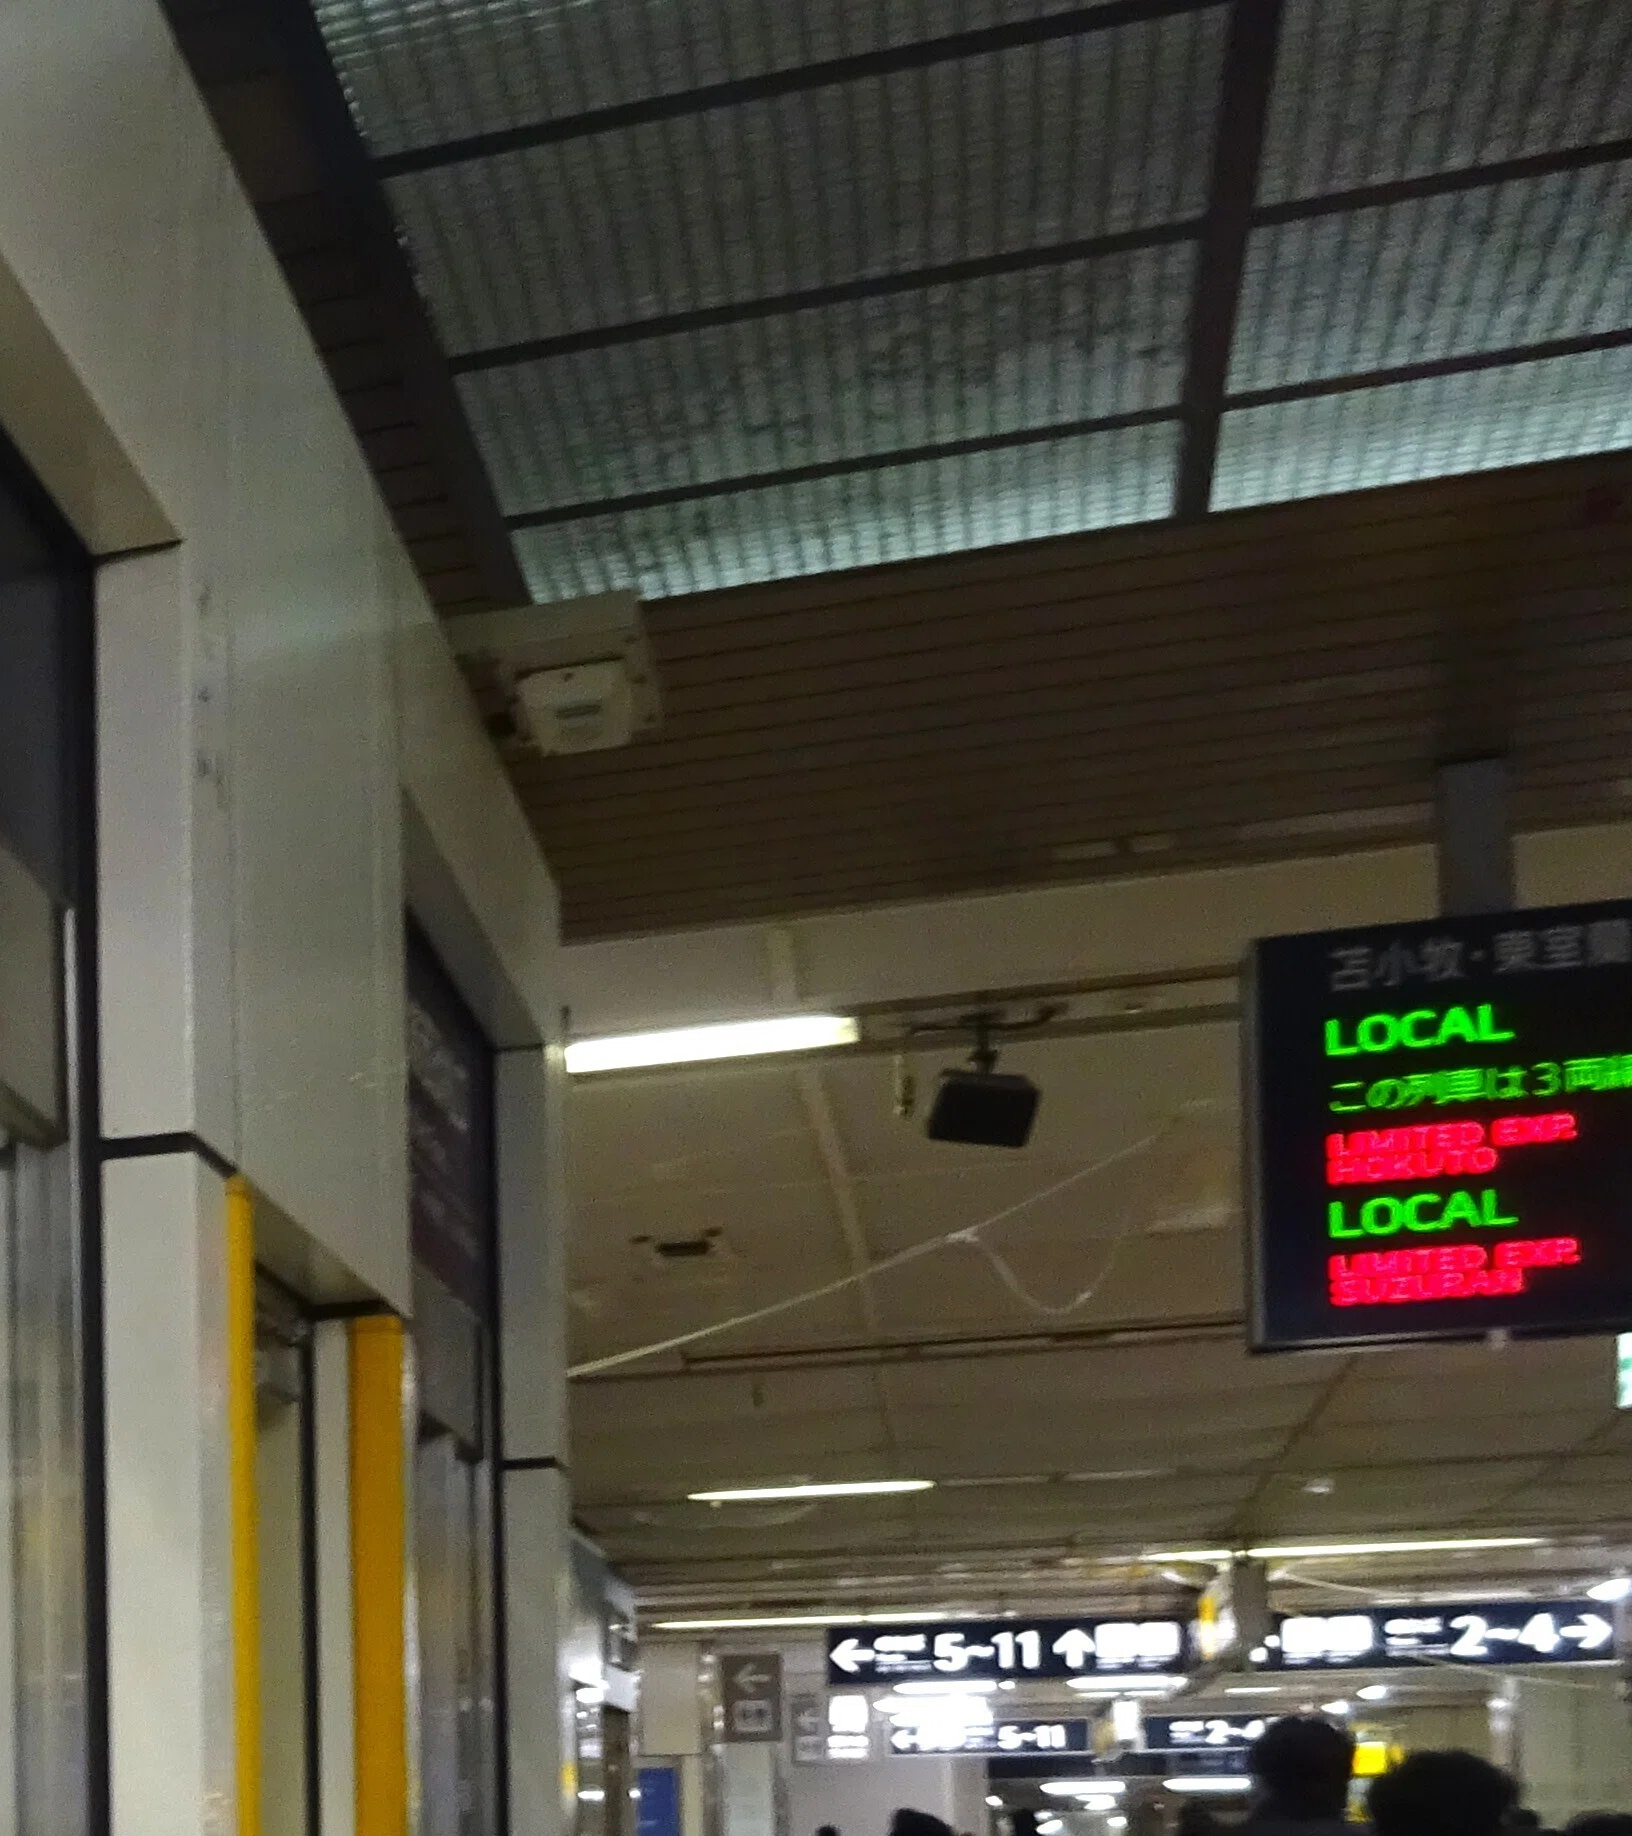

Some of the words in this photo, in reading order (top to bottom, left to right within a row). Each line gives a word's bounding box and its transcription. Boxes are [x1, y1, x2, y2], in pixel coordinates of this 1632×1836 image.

[1324, 1004, 1516, 1057] LOCAL
[1325, 1121, 1485, 1160] LIMITED
[1326, 1147, 1499, 1185] HOKUTO
[1328, 1189, 1520, 1239] LOCAL
[1328, 1244, 1488, 1280] LIMITED
